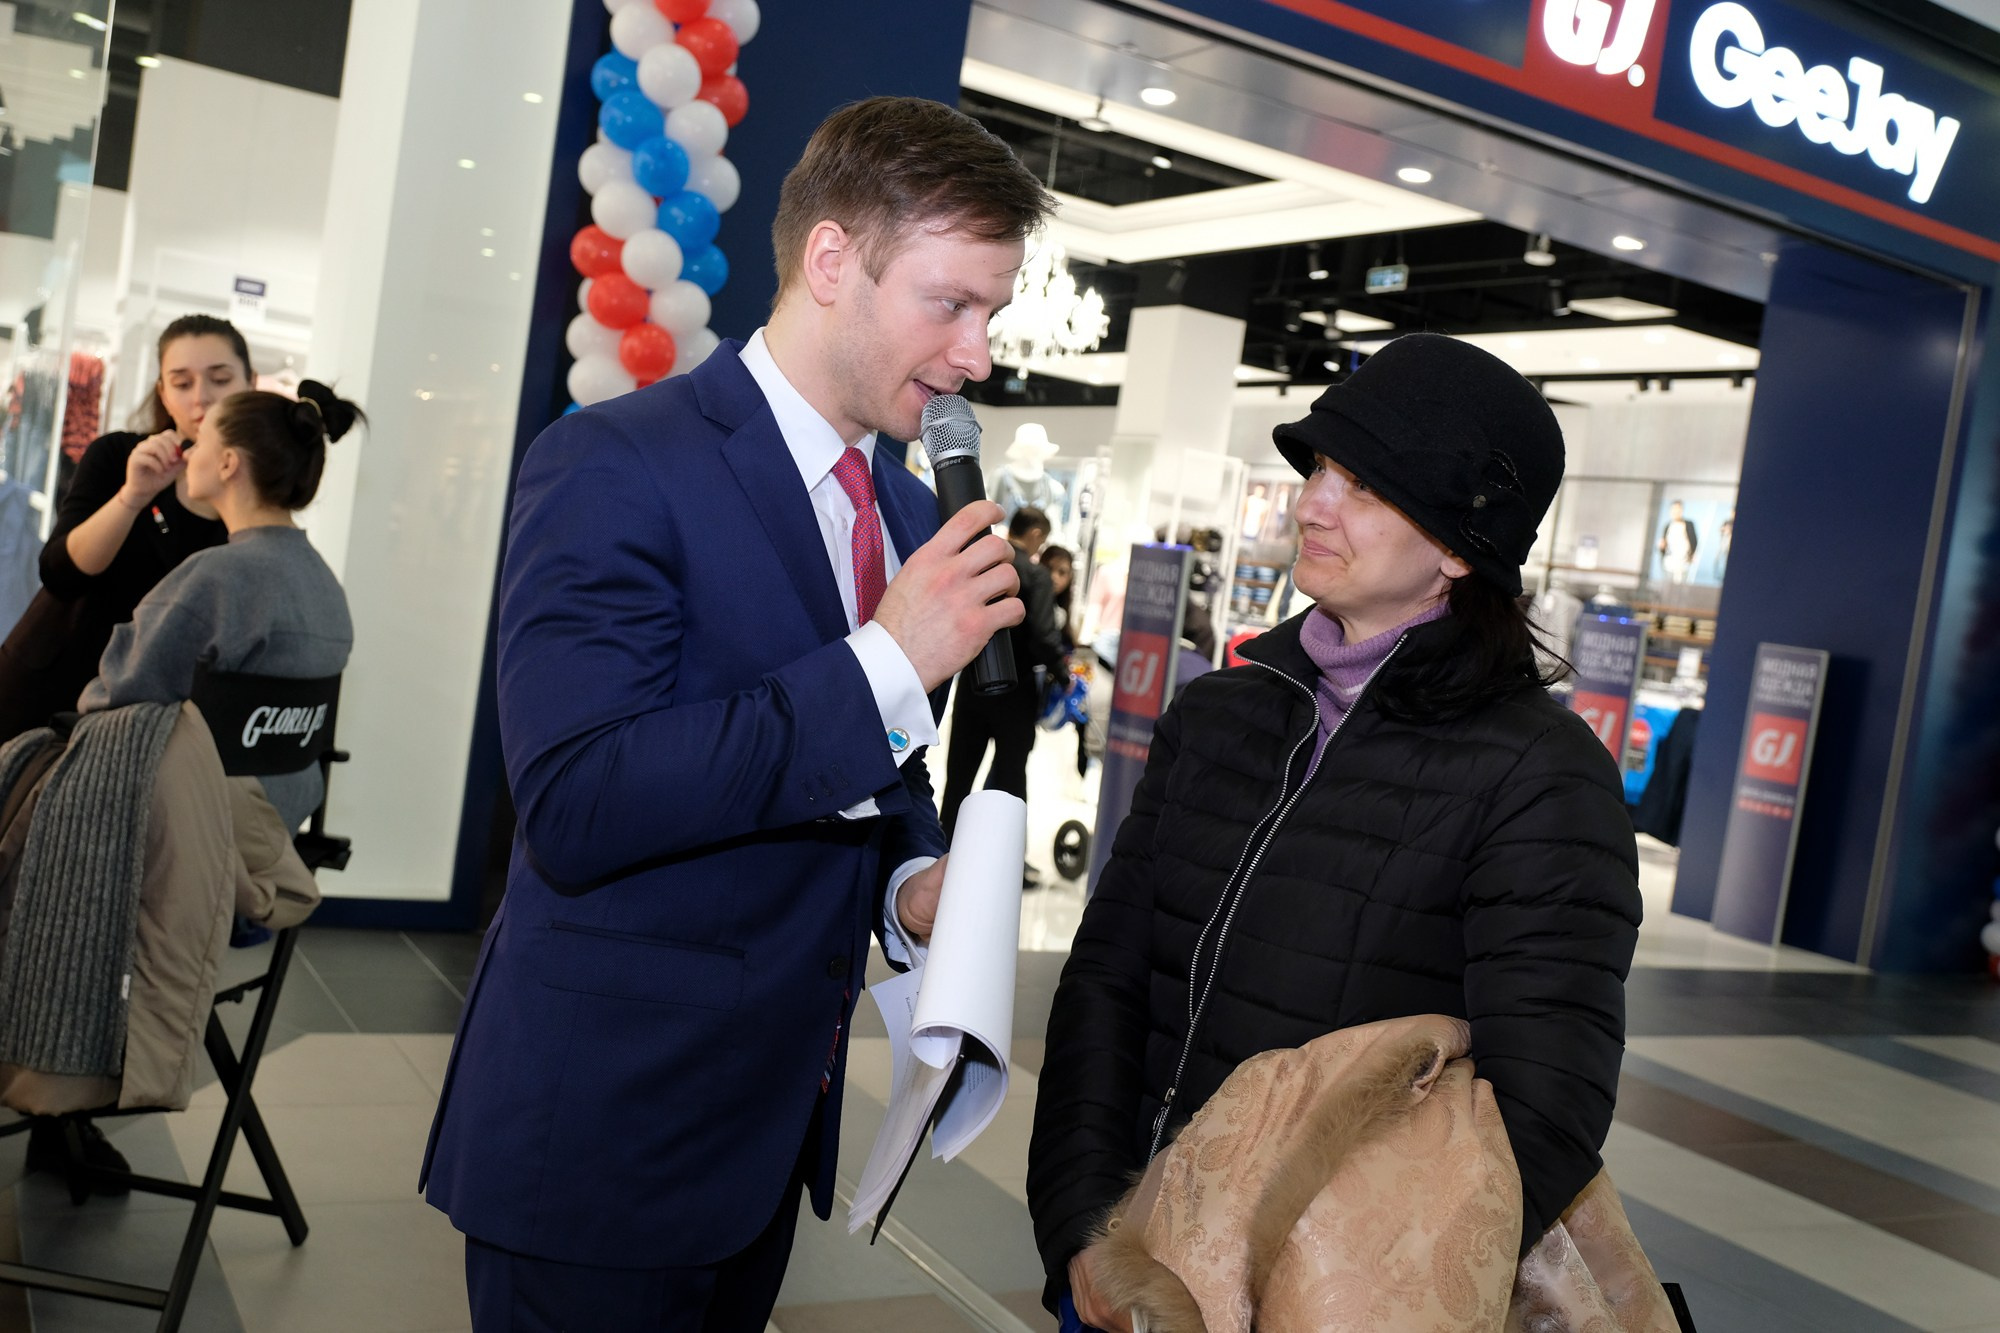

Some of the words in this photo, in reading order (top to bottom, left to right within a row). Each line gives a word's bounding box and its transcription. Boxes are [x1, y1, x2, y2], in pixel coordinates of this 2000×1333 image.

[1690, 2, 1961, 204] GeeJay
[1121, 649, 1159, 696] GJ
[1753, 729, 1796, 768] GJ
